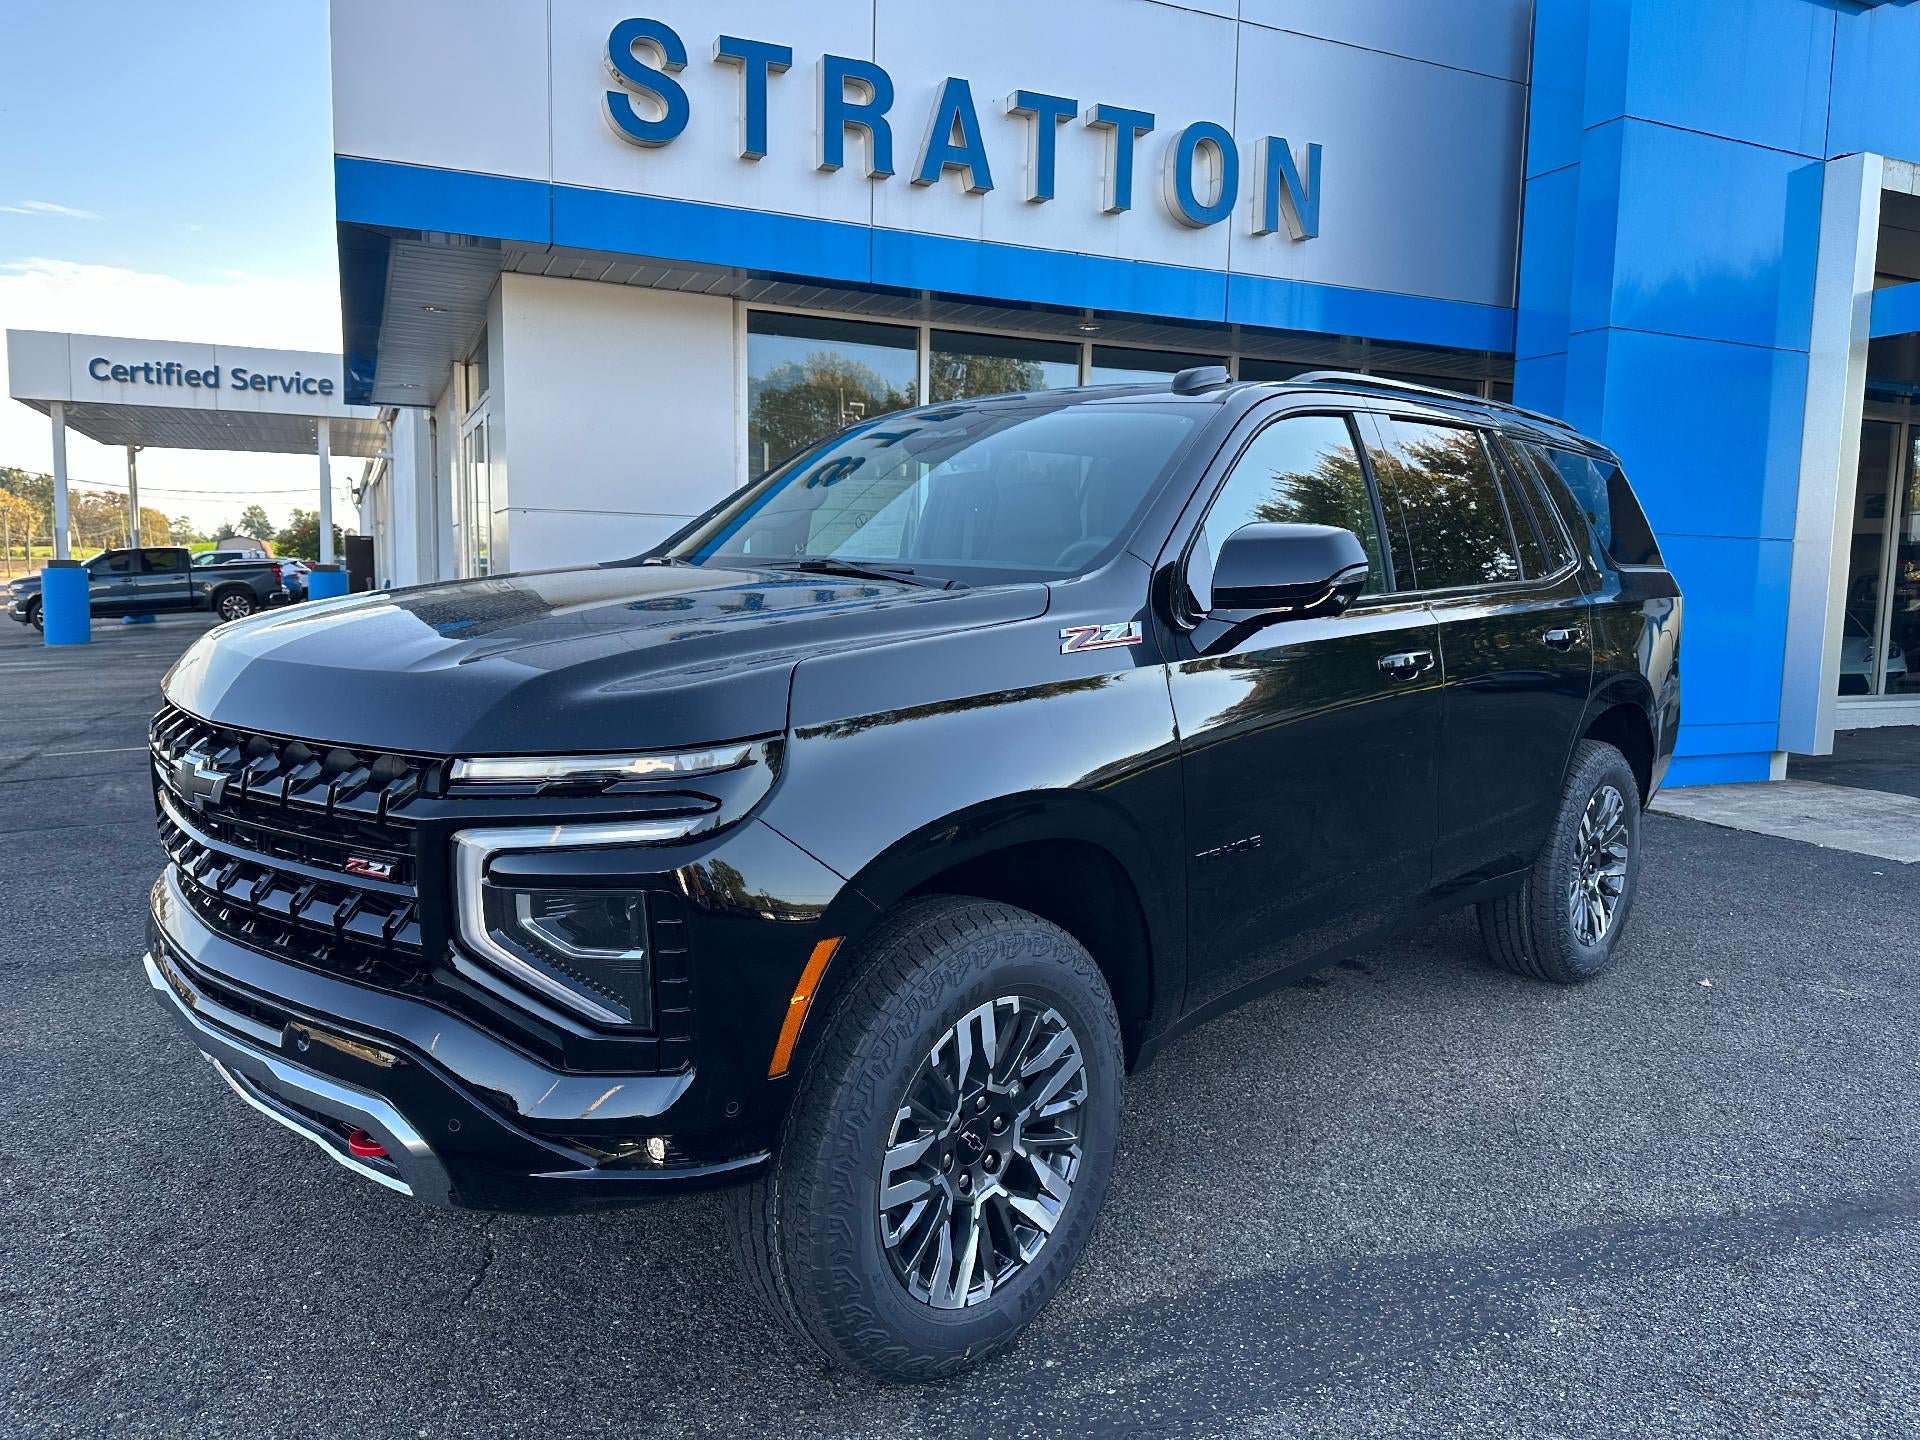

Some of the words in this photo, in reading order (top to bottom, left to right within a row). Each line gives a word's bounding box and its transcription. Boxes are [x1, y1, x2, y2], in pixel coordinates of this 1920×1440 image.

[602, 16, 1323, 241] STRATTON
[88, 356, 220, 389] Certified
[231, 367, 334, 396] Service
[1059, 621, 1143, 655] Z71
[344, 856, 395, 879] Z71
